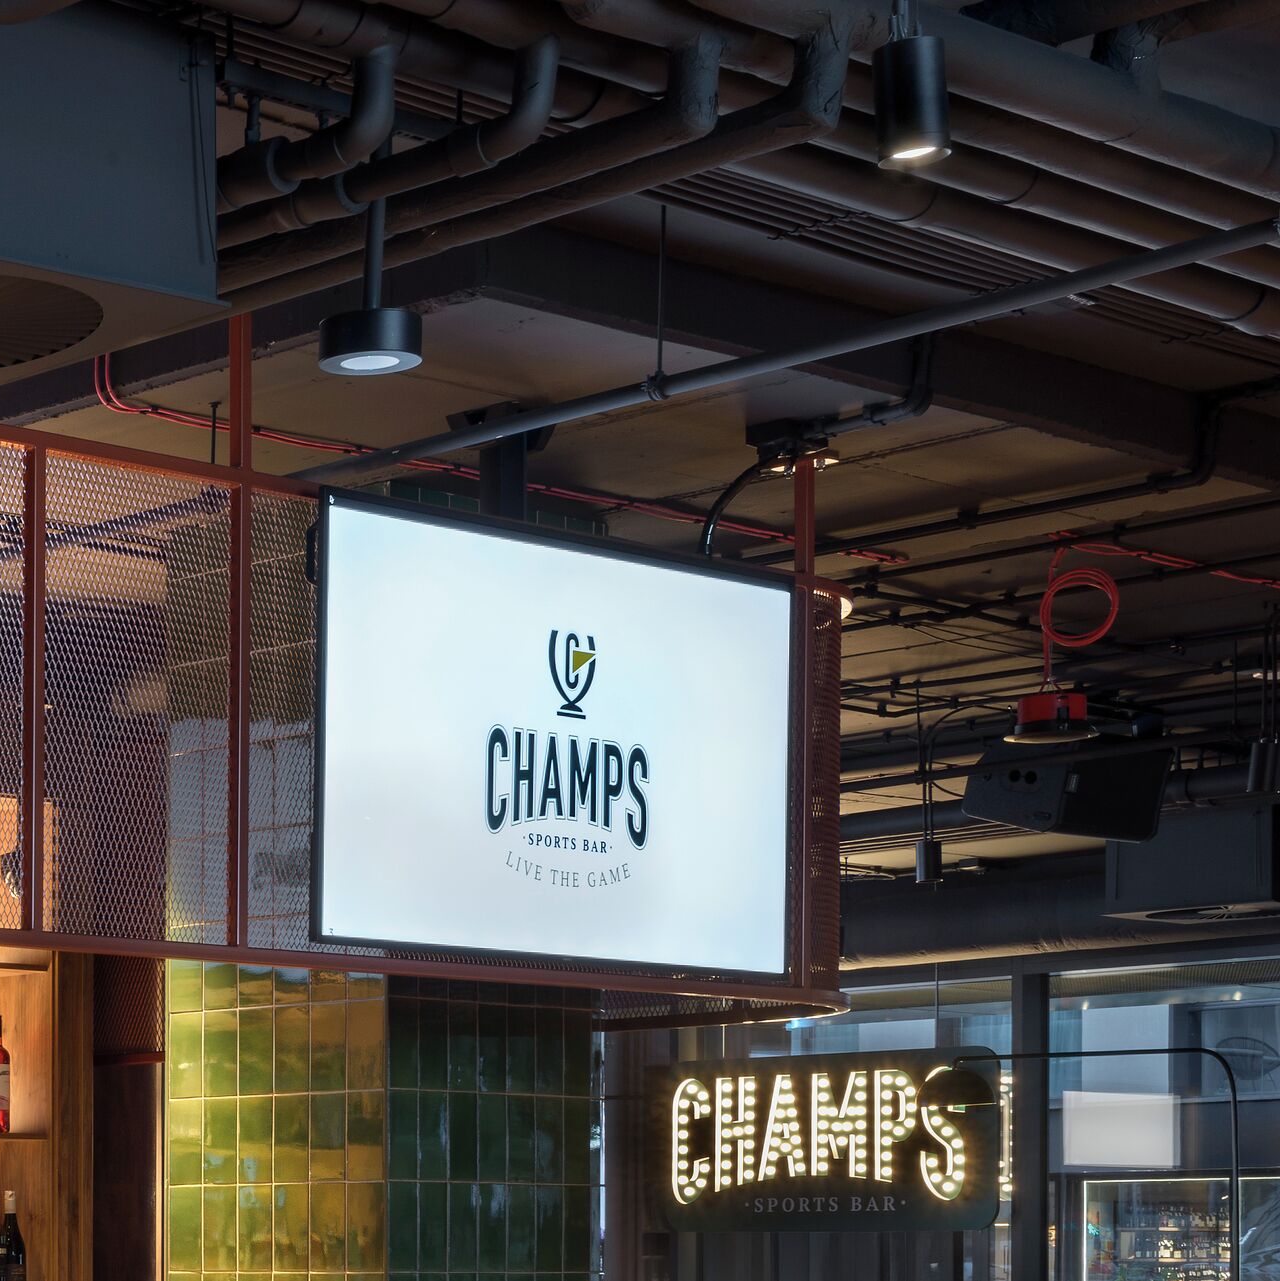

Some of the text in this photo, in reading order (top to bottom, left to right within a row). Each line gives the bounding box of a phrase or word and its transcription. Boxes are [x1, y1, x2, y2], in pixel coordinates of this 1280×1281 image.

[486, 725, 649, 849] CHAMPS
[527, 833, 608, 854] SPORTS BAR
[505, 851, 631, 888] LIVE THE GAME
[671, 1065, 967, 1205] CHAMPS
[754, 1195, 897, 1213] SPORTS BAR
